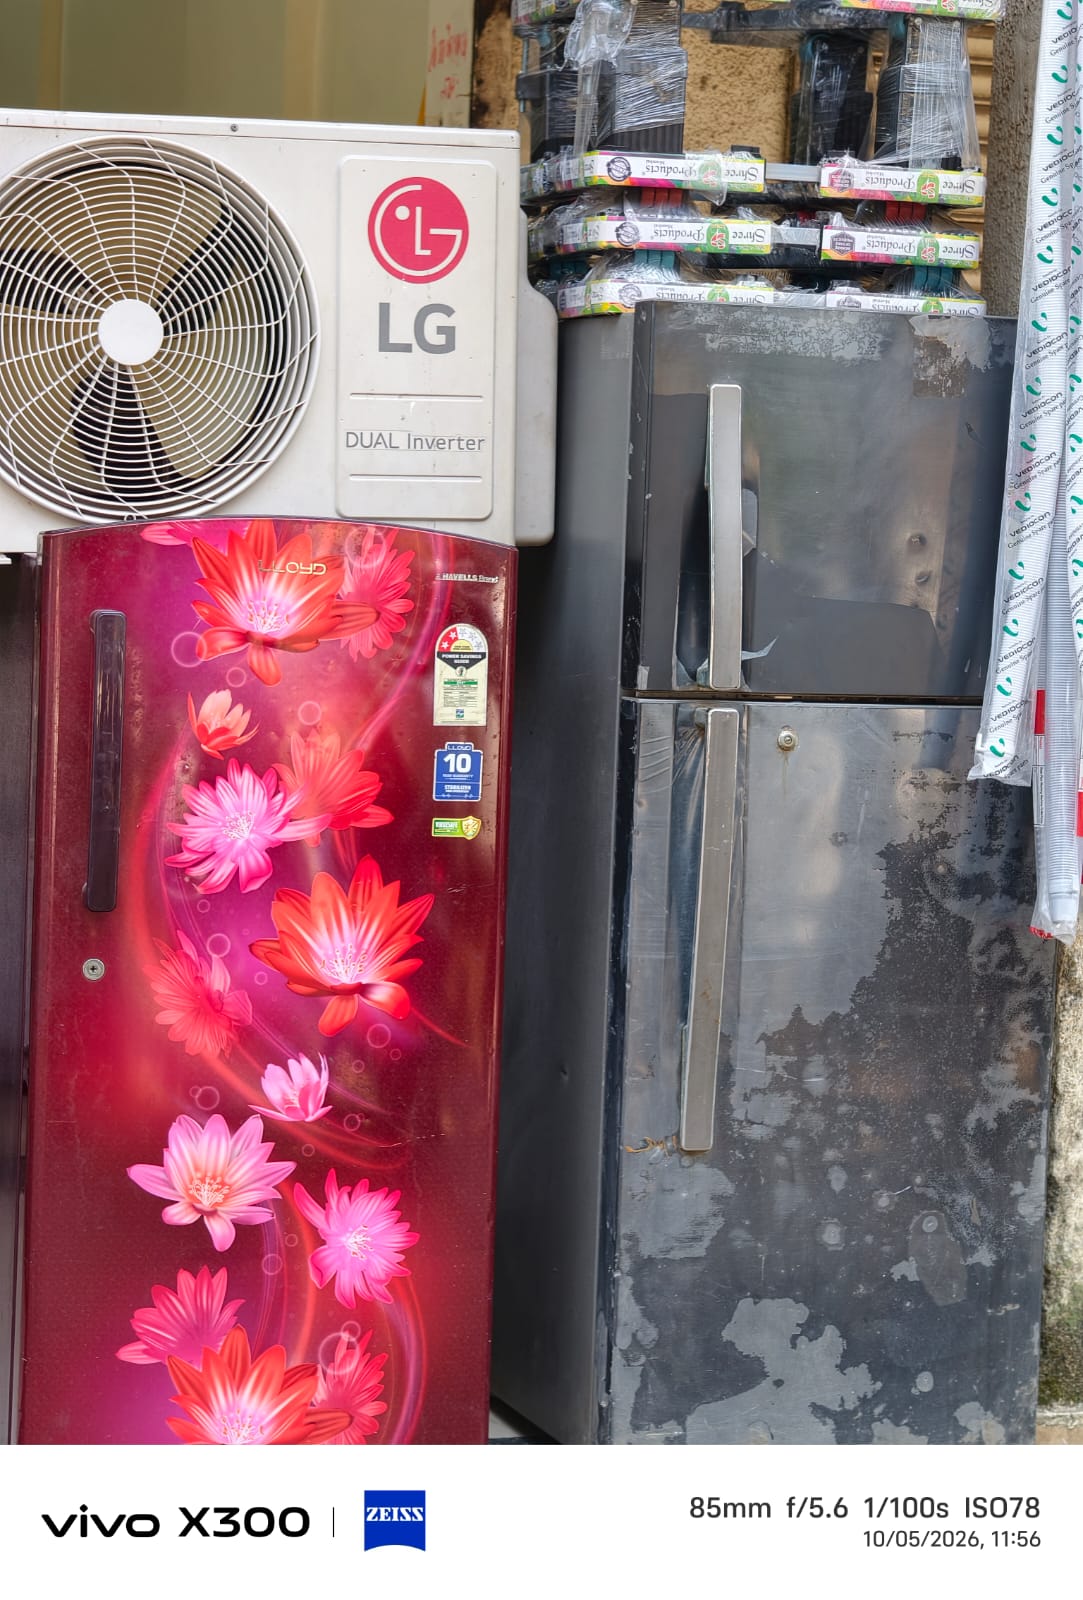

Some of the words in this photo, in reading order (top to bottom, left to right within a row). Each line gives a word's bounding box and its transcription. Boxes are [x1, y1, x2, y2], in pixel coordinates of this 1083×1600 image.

[725, 166, 759, 182] Shree
[942, 178, 976, 194] Shree
[732, 228, 766, 242] Shree
[942, 244, 976, 258] Shree
[378, 302, 456, 354] LG
[346, 431, 400, 449] DUAL
[407, 432, 486, 451] Inverter
[258, 560, 326, 576] LLOYD
[442, 573, 478, 581] HAVELLS
[443, 754, 472, 773] 10
